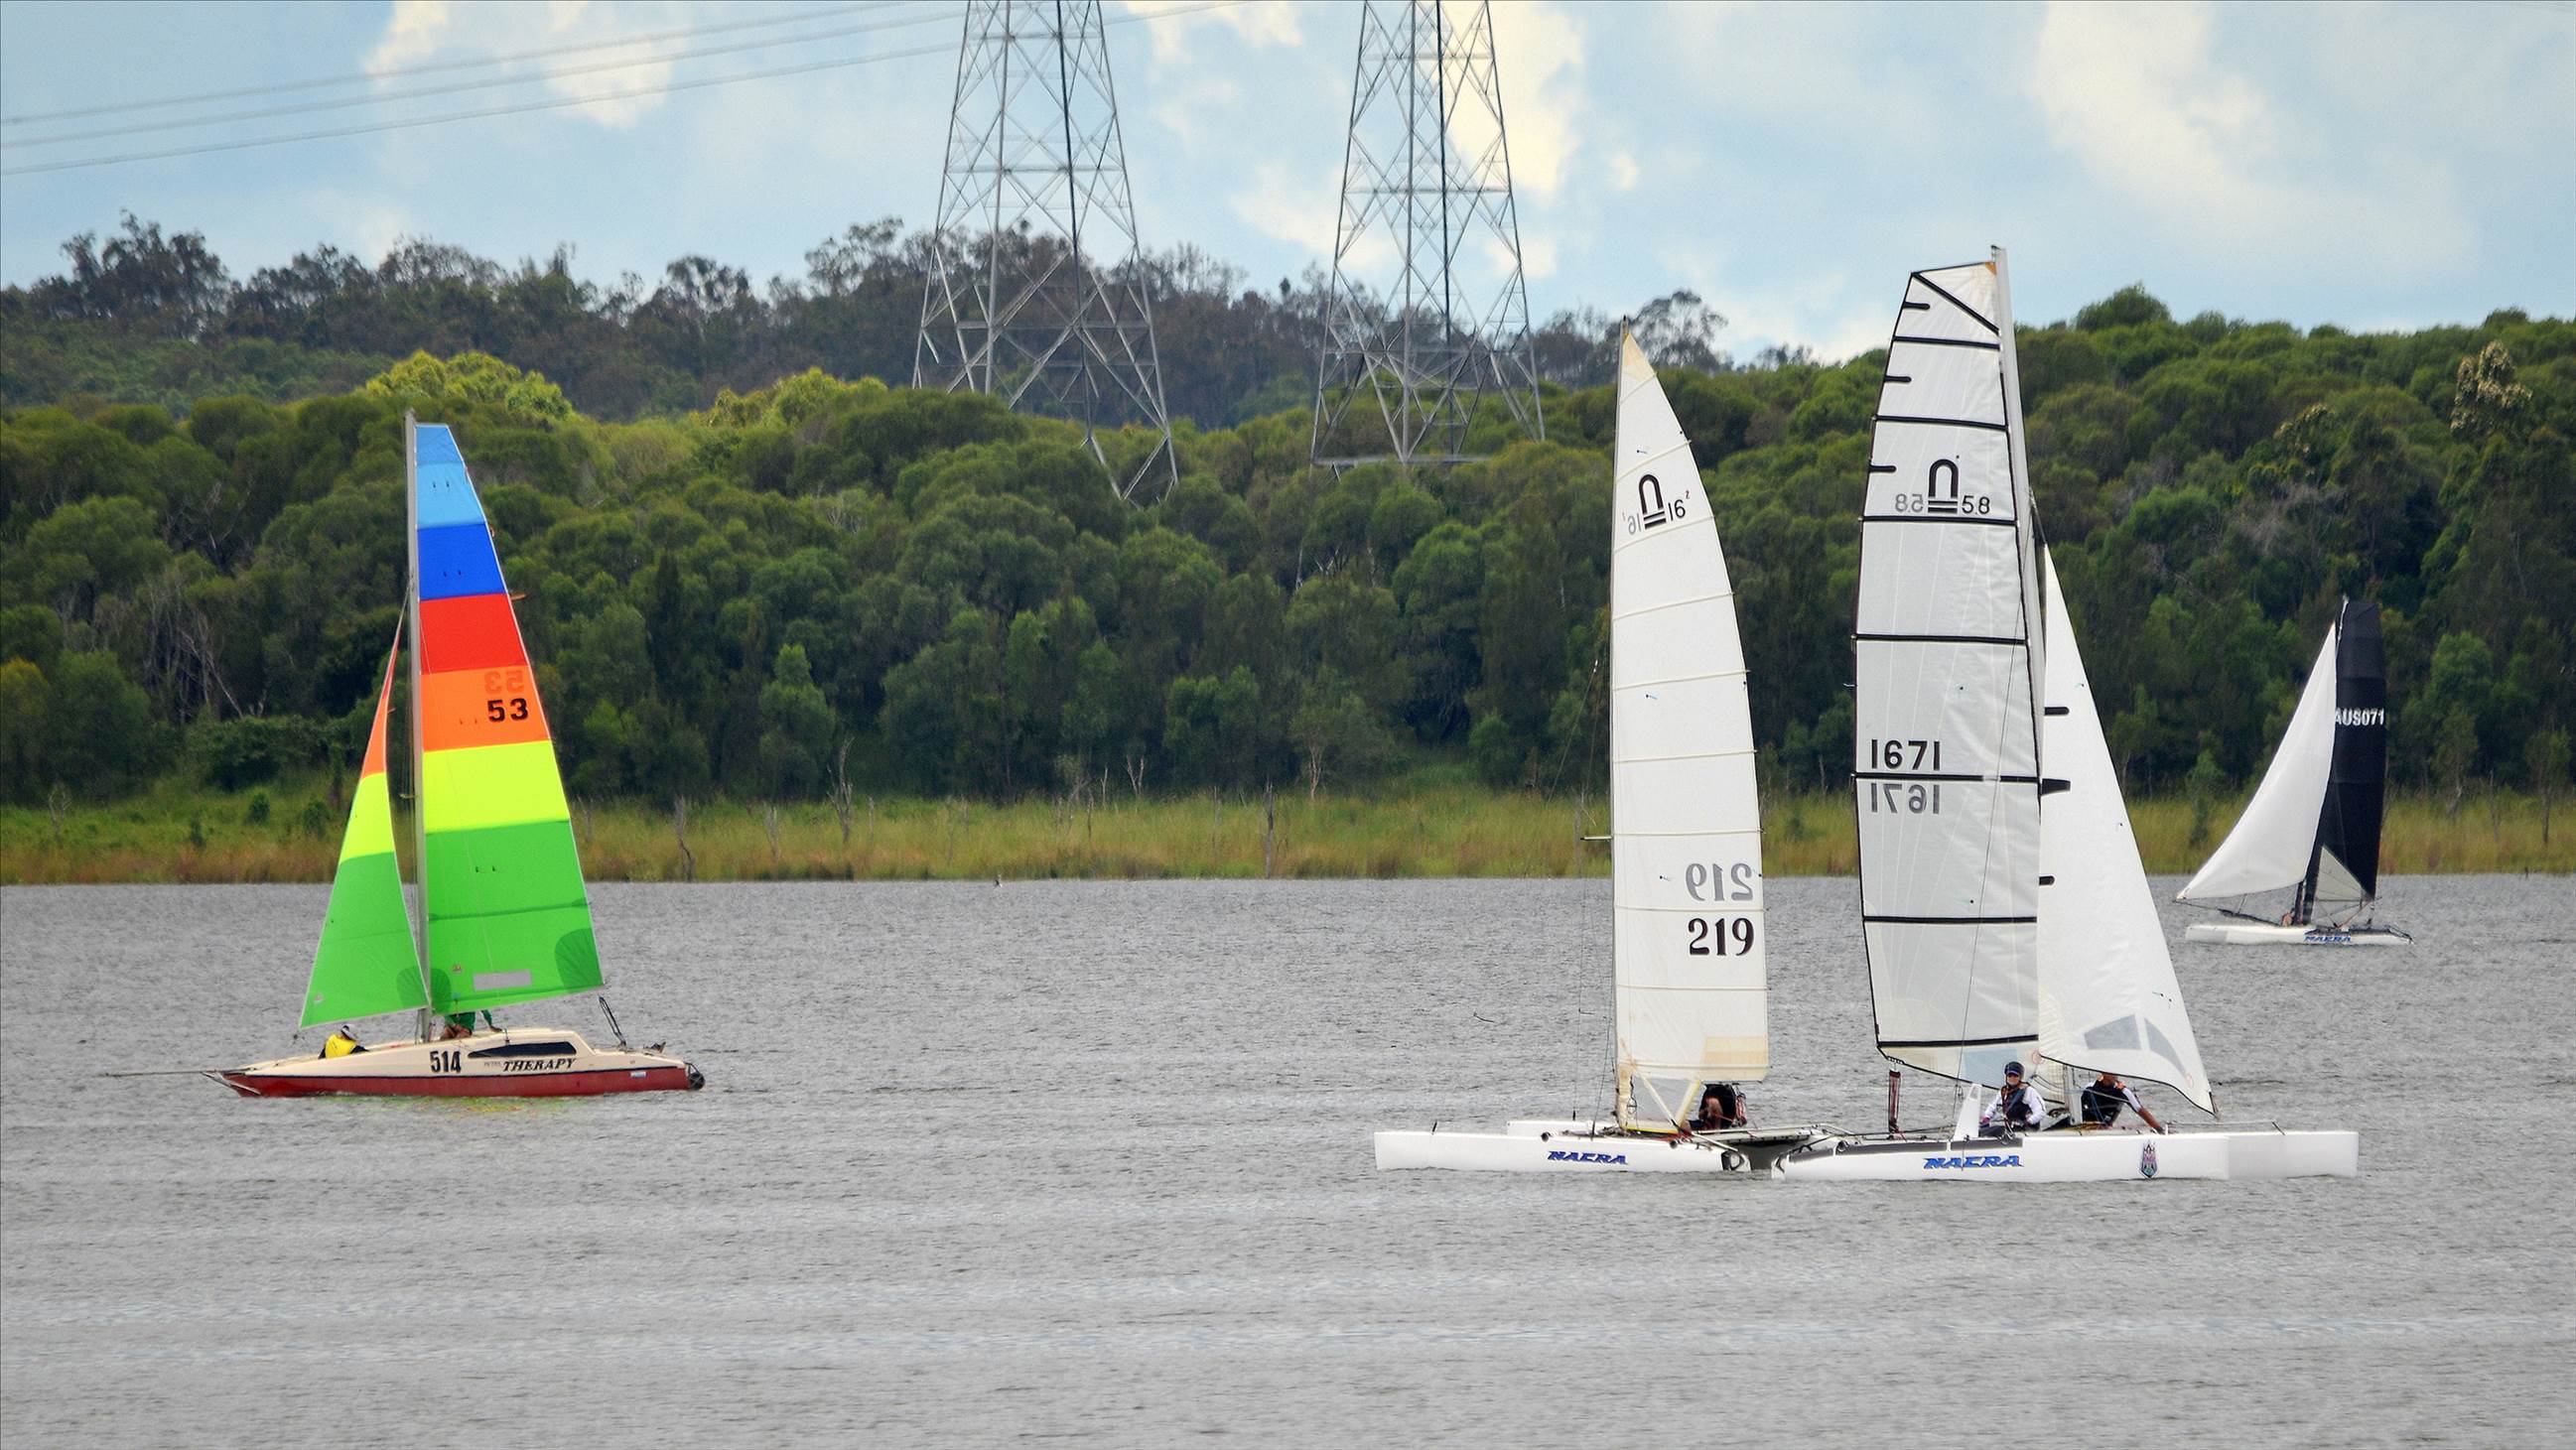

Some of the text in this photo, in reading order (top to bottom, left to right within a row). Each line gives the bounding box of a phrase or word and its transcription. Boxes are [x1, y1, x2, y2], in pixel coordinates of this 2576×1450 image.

[487, 698, 528, 723] 53
[2335, 708, 2384, 725] AUS071
[1871, 739, 1940, 770] 1671
[1688, 917, 1754, 956] 219
[430, 1050, 462, 1073] 514
[502, 1058, 577, 1072] THERAPY
[1548, 1151, 1628, 1164] NACRA
[1923, 1155, 2024, 1169] NACRA
